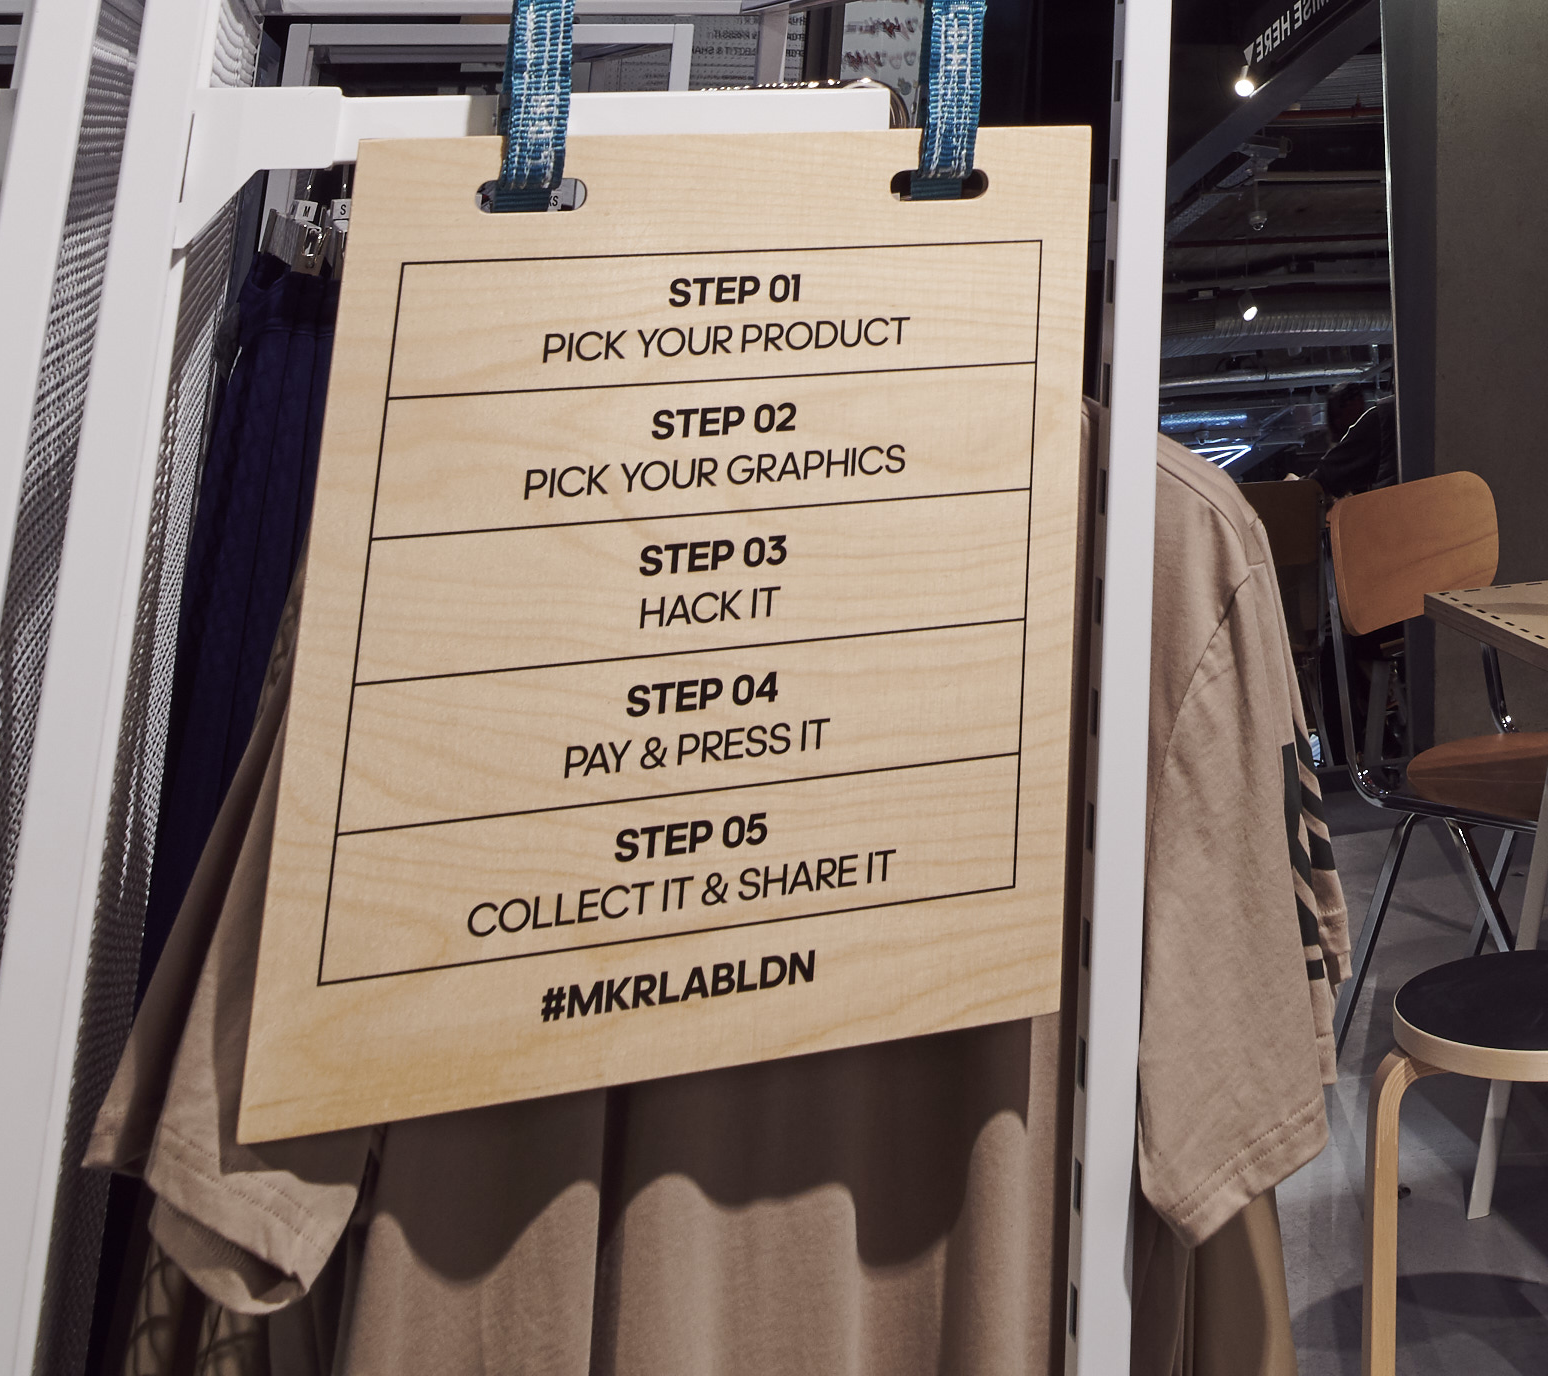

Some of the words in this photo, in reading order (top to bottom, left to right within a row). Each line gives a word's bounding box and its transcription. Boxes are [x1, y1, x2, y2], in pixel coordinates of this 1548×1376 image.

[303, 206, 310, 217] M
[340, 204, 346, 215] S
[669, 276, 760, 307] STEP
[770, 274, 800, 302] 01
[543, 330, 627, 363] PICK
[638, 326, 732, 358] YOUR
[741, 317, 910, 353] PRODUCT
[652, 406, 745, 440] STEP
[754, 403, 796, 433] 02
[524, 465, 610, 500] PICK
[621, 458, 718, 492] YOUR
[727, 445, 905, 485] GRAPHICS
[640, 540, 734, 576] STEP
[744, 535, 787, 567] 03
[640, 590, 742, 629] HACK
[751, 586, 781, 618] IT
[627, 678, 723, 717] STEP
[733, 672, 778, 705] 04
[564, 740, 632, 778] PAY
[640, 737, 667, 769] &
[677, 723, 790, 765] PRESS
[801, 718, 830, 751] IT
[615, 820, 713, 862] STEP
[723, 812, 767, 848] 05
[468, 881, 654, 937] COLLECT
[662, 876, 694, 911] IT
[702, 873, 728, 906] &
[738, 854, 858, 900] SHARE
[867, 849, 896, 883] IT
[541, 950, 815, 1022] #MKRLABLDN
